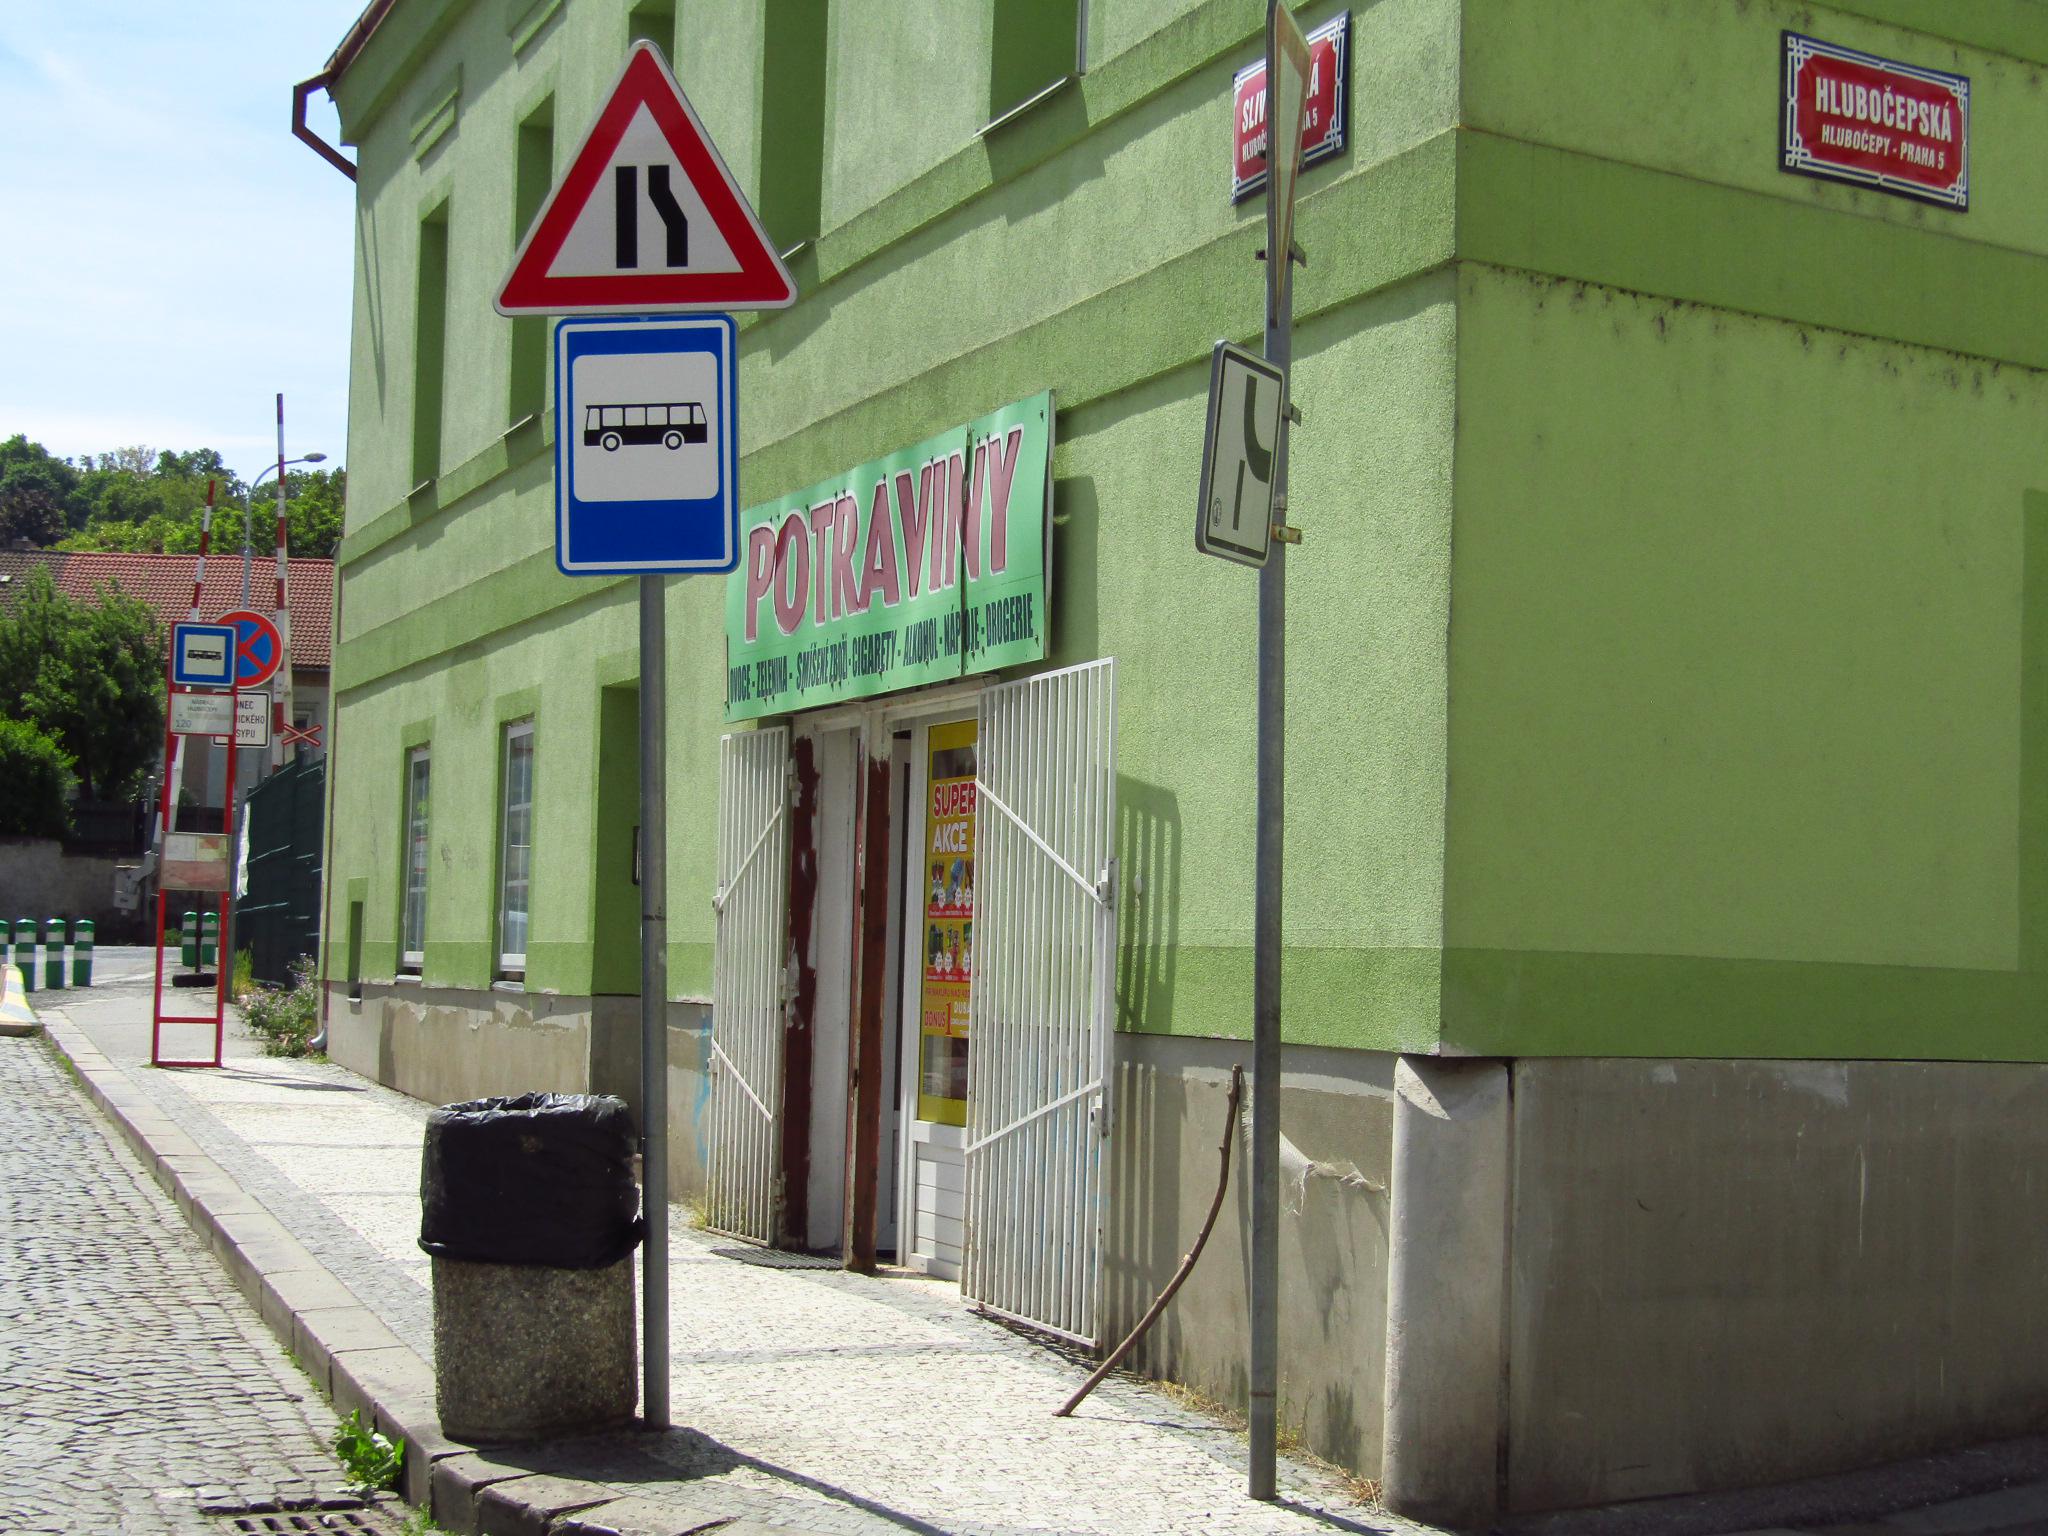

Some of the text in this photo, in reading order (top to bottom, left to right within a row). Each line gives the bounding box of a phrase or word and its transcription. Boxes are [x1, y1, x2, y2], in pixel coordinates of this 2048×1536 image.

[1312, 107, 1318, 127] 5
[1816, 76, 1952, 142] HLUBOČEPSKÁ
[1822, 124, 1890, 157] HLUBOČEPY
[1900, 142, 1935, 168] PRAHA
[1937, 151, 1945, 170] 5
[745, 424, 1024, 644] POTRAVINY
[730, 664, 750, 704] OVOCE
[756, 656, 788, 698] ZELENINA
[852, 630, 897, 678] CIGARETY
[903, 618, 938, 666] ALKOHOL
[985, 593, 1034, 647] DROGERIE
[238, 713, 265, 724] ICKÉHO
[240, 701, 254, 709] NEC
[176, 719, 192, 728] 120
[236, 729, 255, 738] SYPU
[934, 781, 976, 818] SUPER
[932, 821, 968, 853] AKCE
